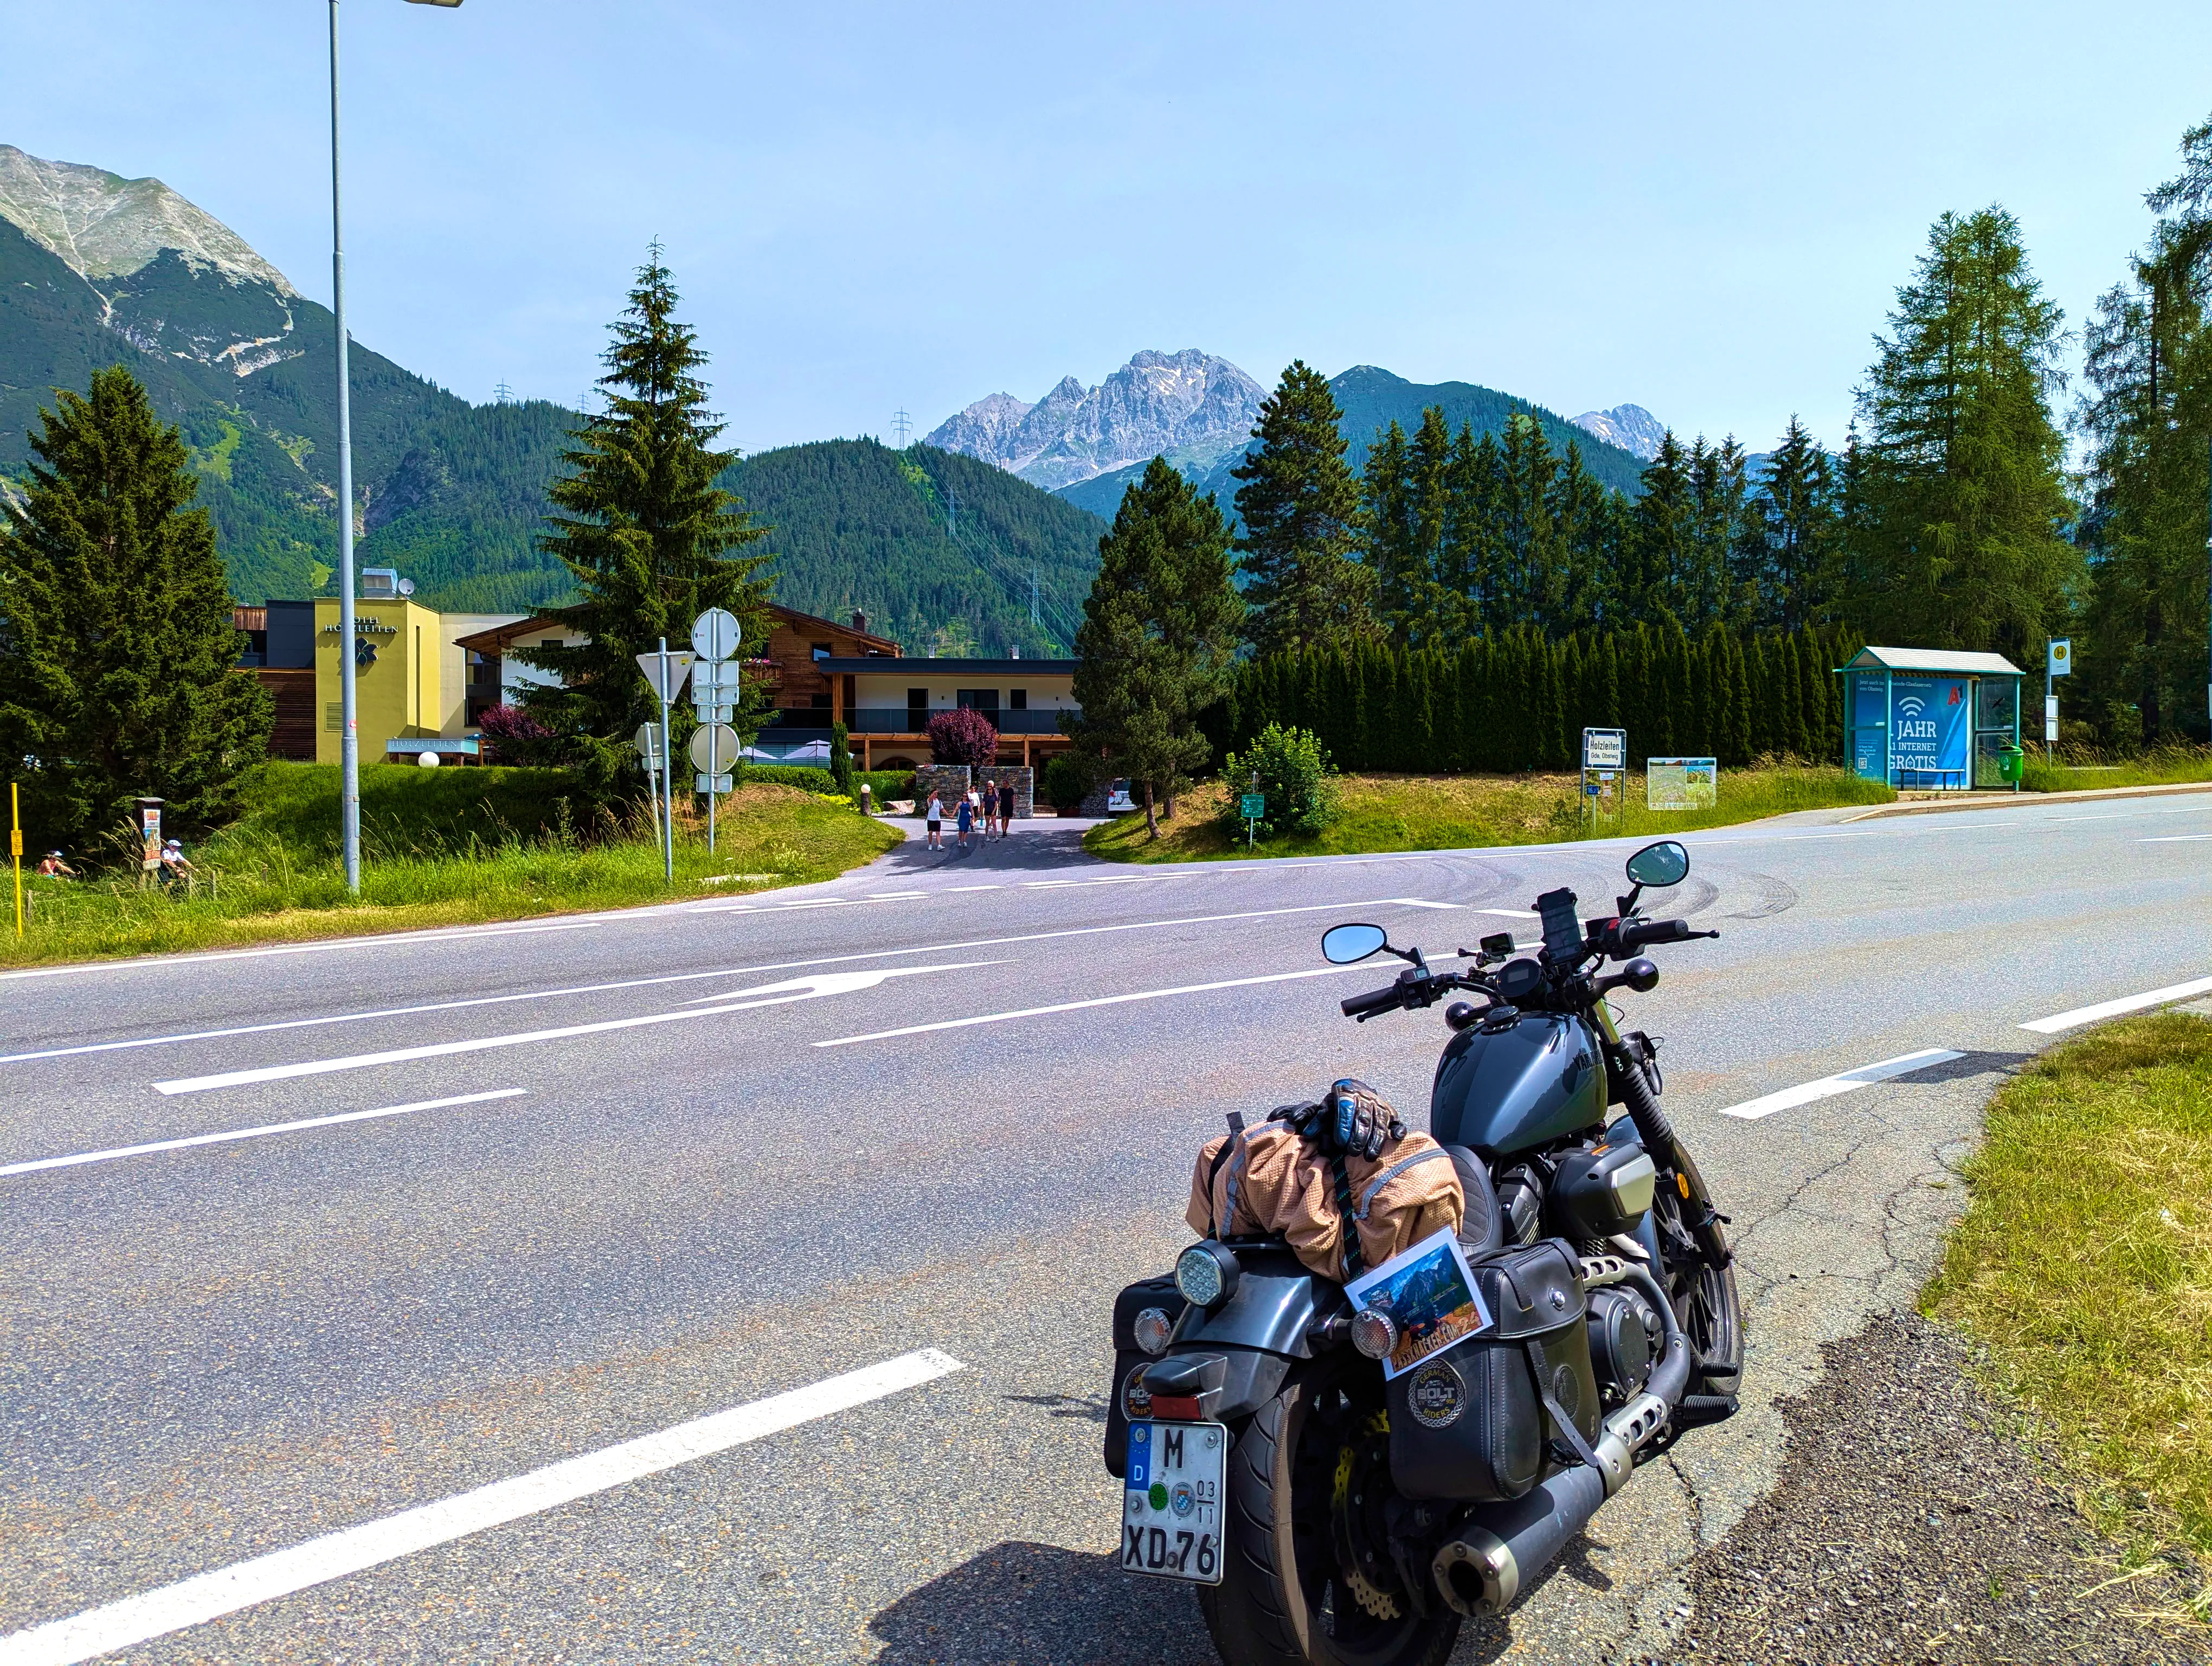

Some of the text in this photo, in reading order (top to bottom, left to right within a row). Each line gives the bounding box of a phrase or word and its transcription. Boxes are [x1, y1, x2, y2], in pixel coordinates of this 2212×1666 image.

[325, 624, 399, 633] HOLEITEN
[1947, 684, 1963, 706] A1
[1898, 720, 1937, 740] JAHR
[1590, 740, 1619, 751] Holzleiten
[1898, 742, 1937, 751] INTERNET
[1602, 752, 1618, 761] Obsteig
[1392, 1311, 1481, 1371] PASSKNACKER.COM 24
[1419, 1369, 1451, 1384] GERMAN
[1417, 1387, 1455, 1399] BOLT
[1423, 1406, 1450, 1419] RIDERS
[1164, 1428, 1184, 1469] M
[1133, 1465, 1143, 1481] D
[1197, 1479, 1216, 1498] 03
[1197, 1507, 1213, 1524] 11
